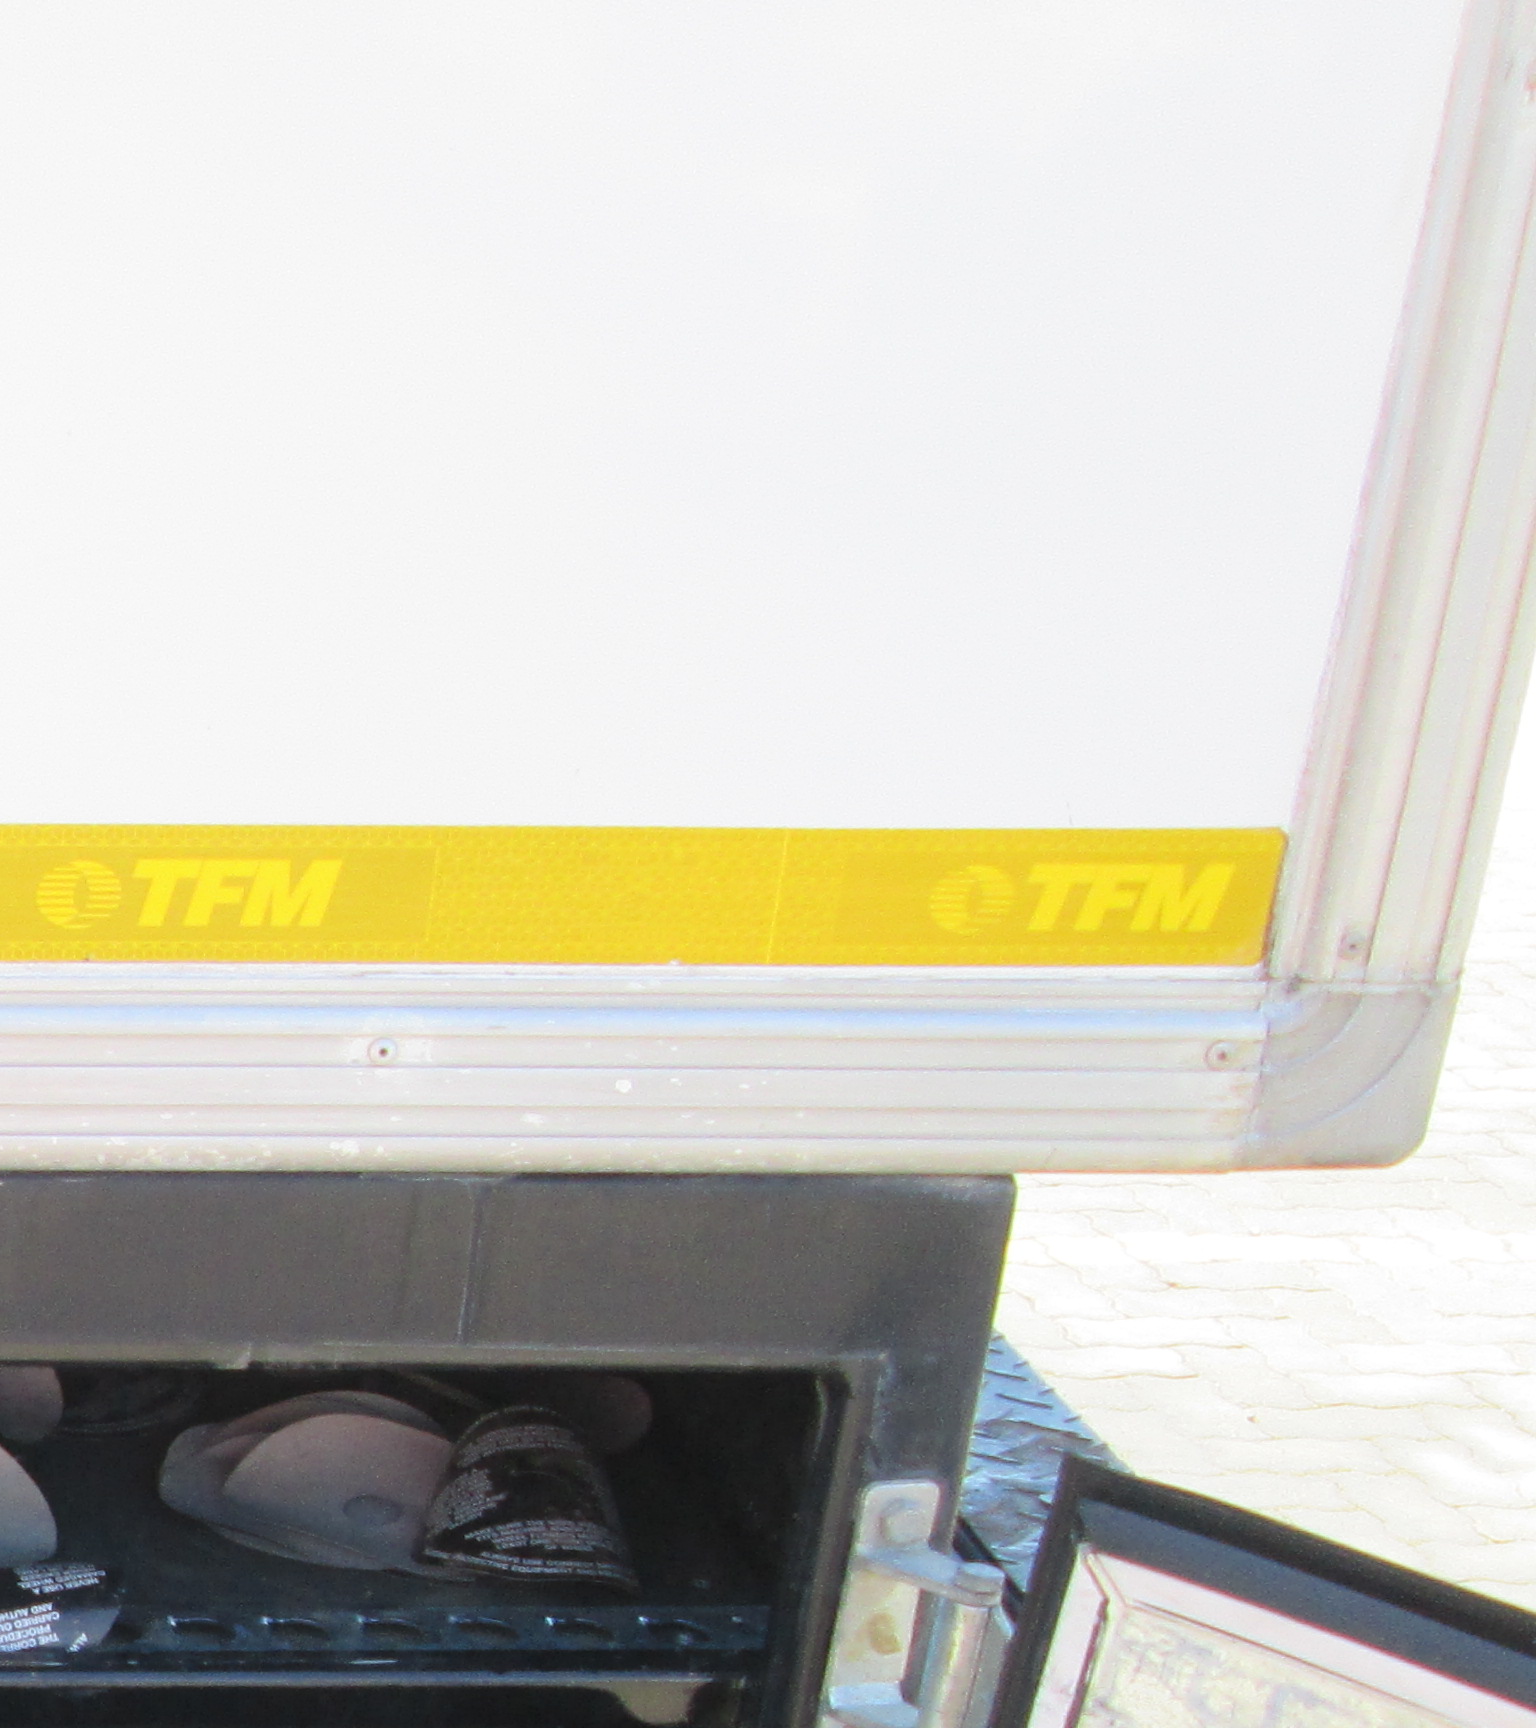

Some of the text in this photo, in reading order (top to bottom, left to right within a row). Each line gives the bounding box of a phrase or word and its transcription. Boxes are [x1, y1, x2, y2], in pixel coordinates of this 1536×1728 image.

[132, 858, 343, 927] TFM
[1027, 863, 1236, 932] TFM
[13, 1611, 60, 1629] CARRIED
[30, 1602, 53, 1615] AND
